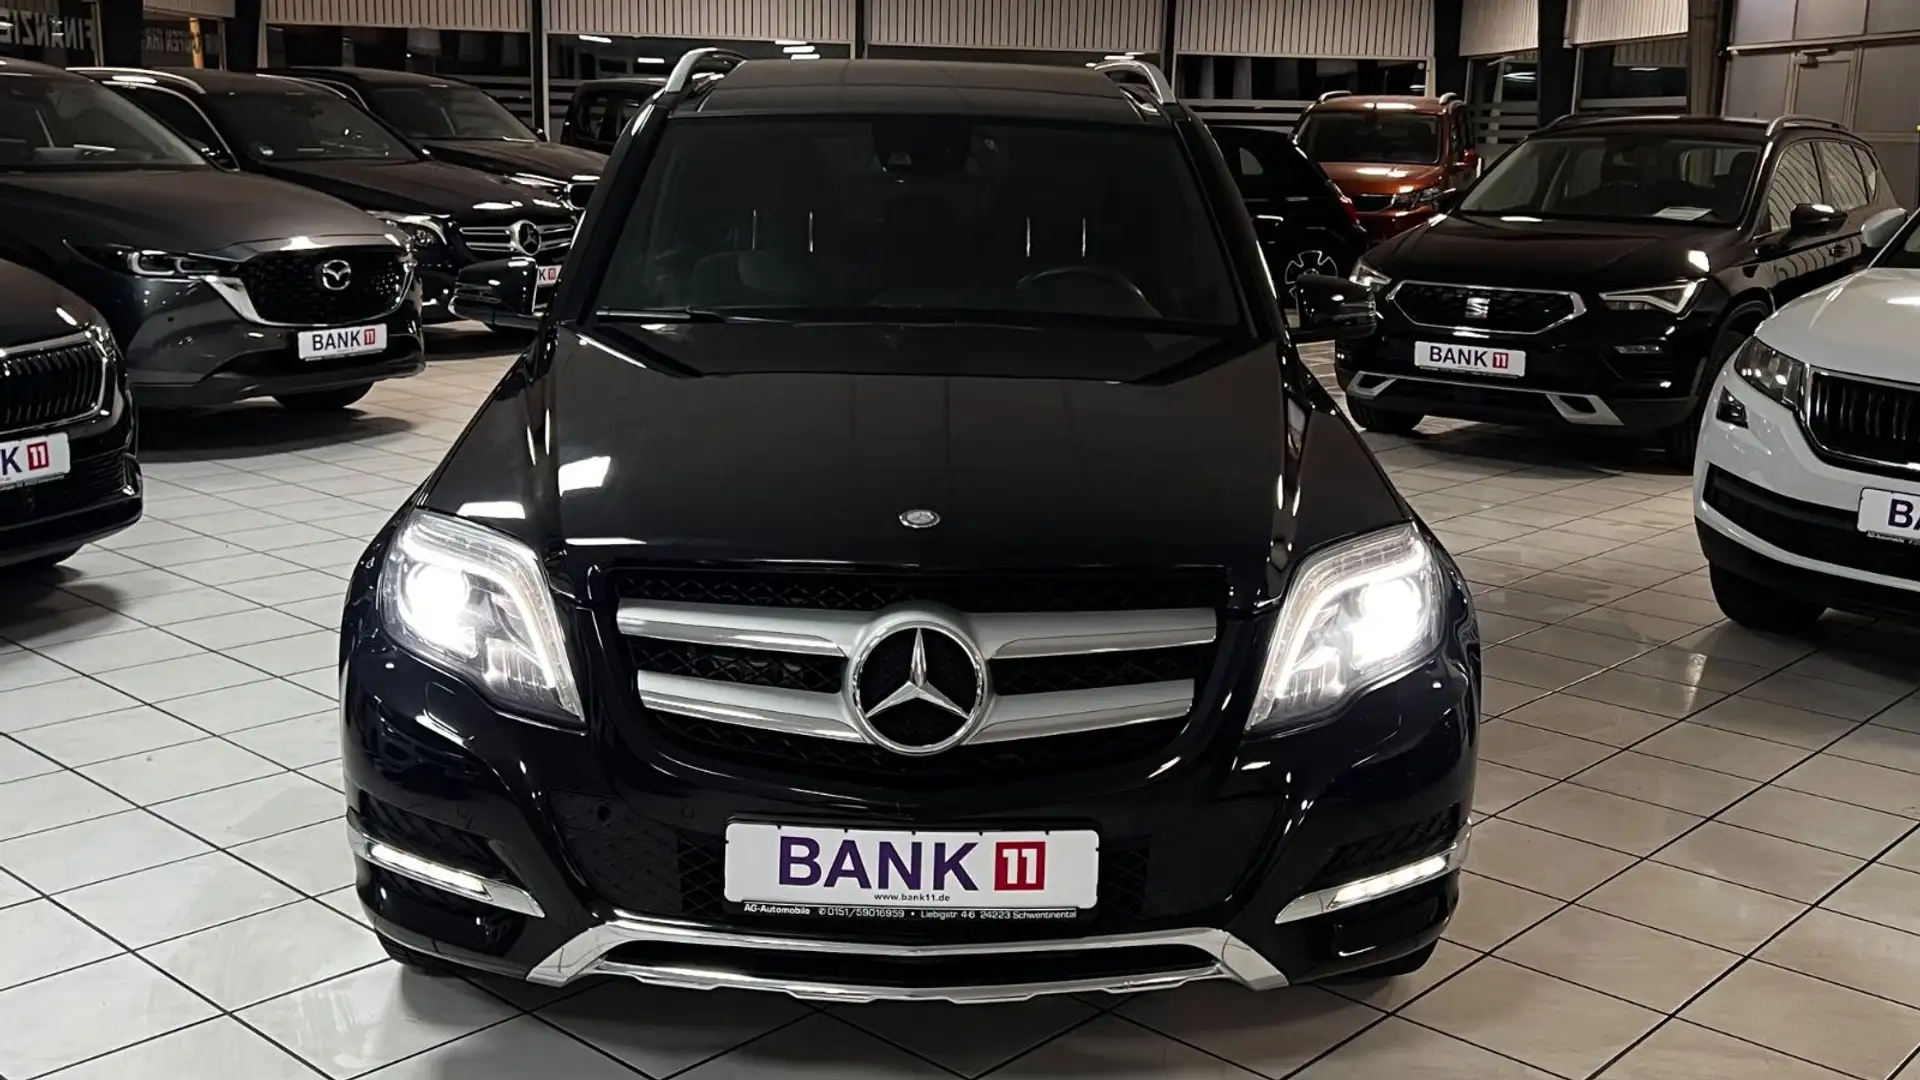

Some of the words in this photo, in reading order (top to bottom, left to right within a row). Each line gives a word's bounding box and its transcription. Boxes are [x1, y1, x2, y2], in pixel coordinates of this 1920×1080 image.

[312, 330, 361, 351] BANK
[1429, 345, 1488, 368] BANK
[1493, 353, 1507, 367] 11
[28, 443, 47, 468] 11
[779, 835, 979, 891] BANK
[998, 845, 1041, 888] 11
[874, 893, 950, 902] www.bank11.de
[743, 903, 811, 915] AG-Automobile
